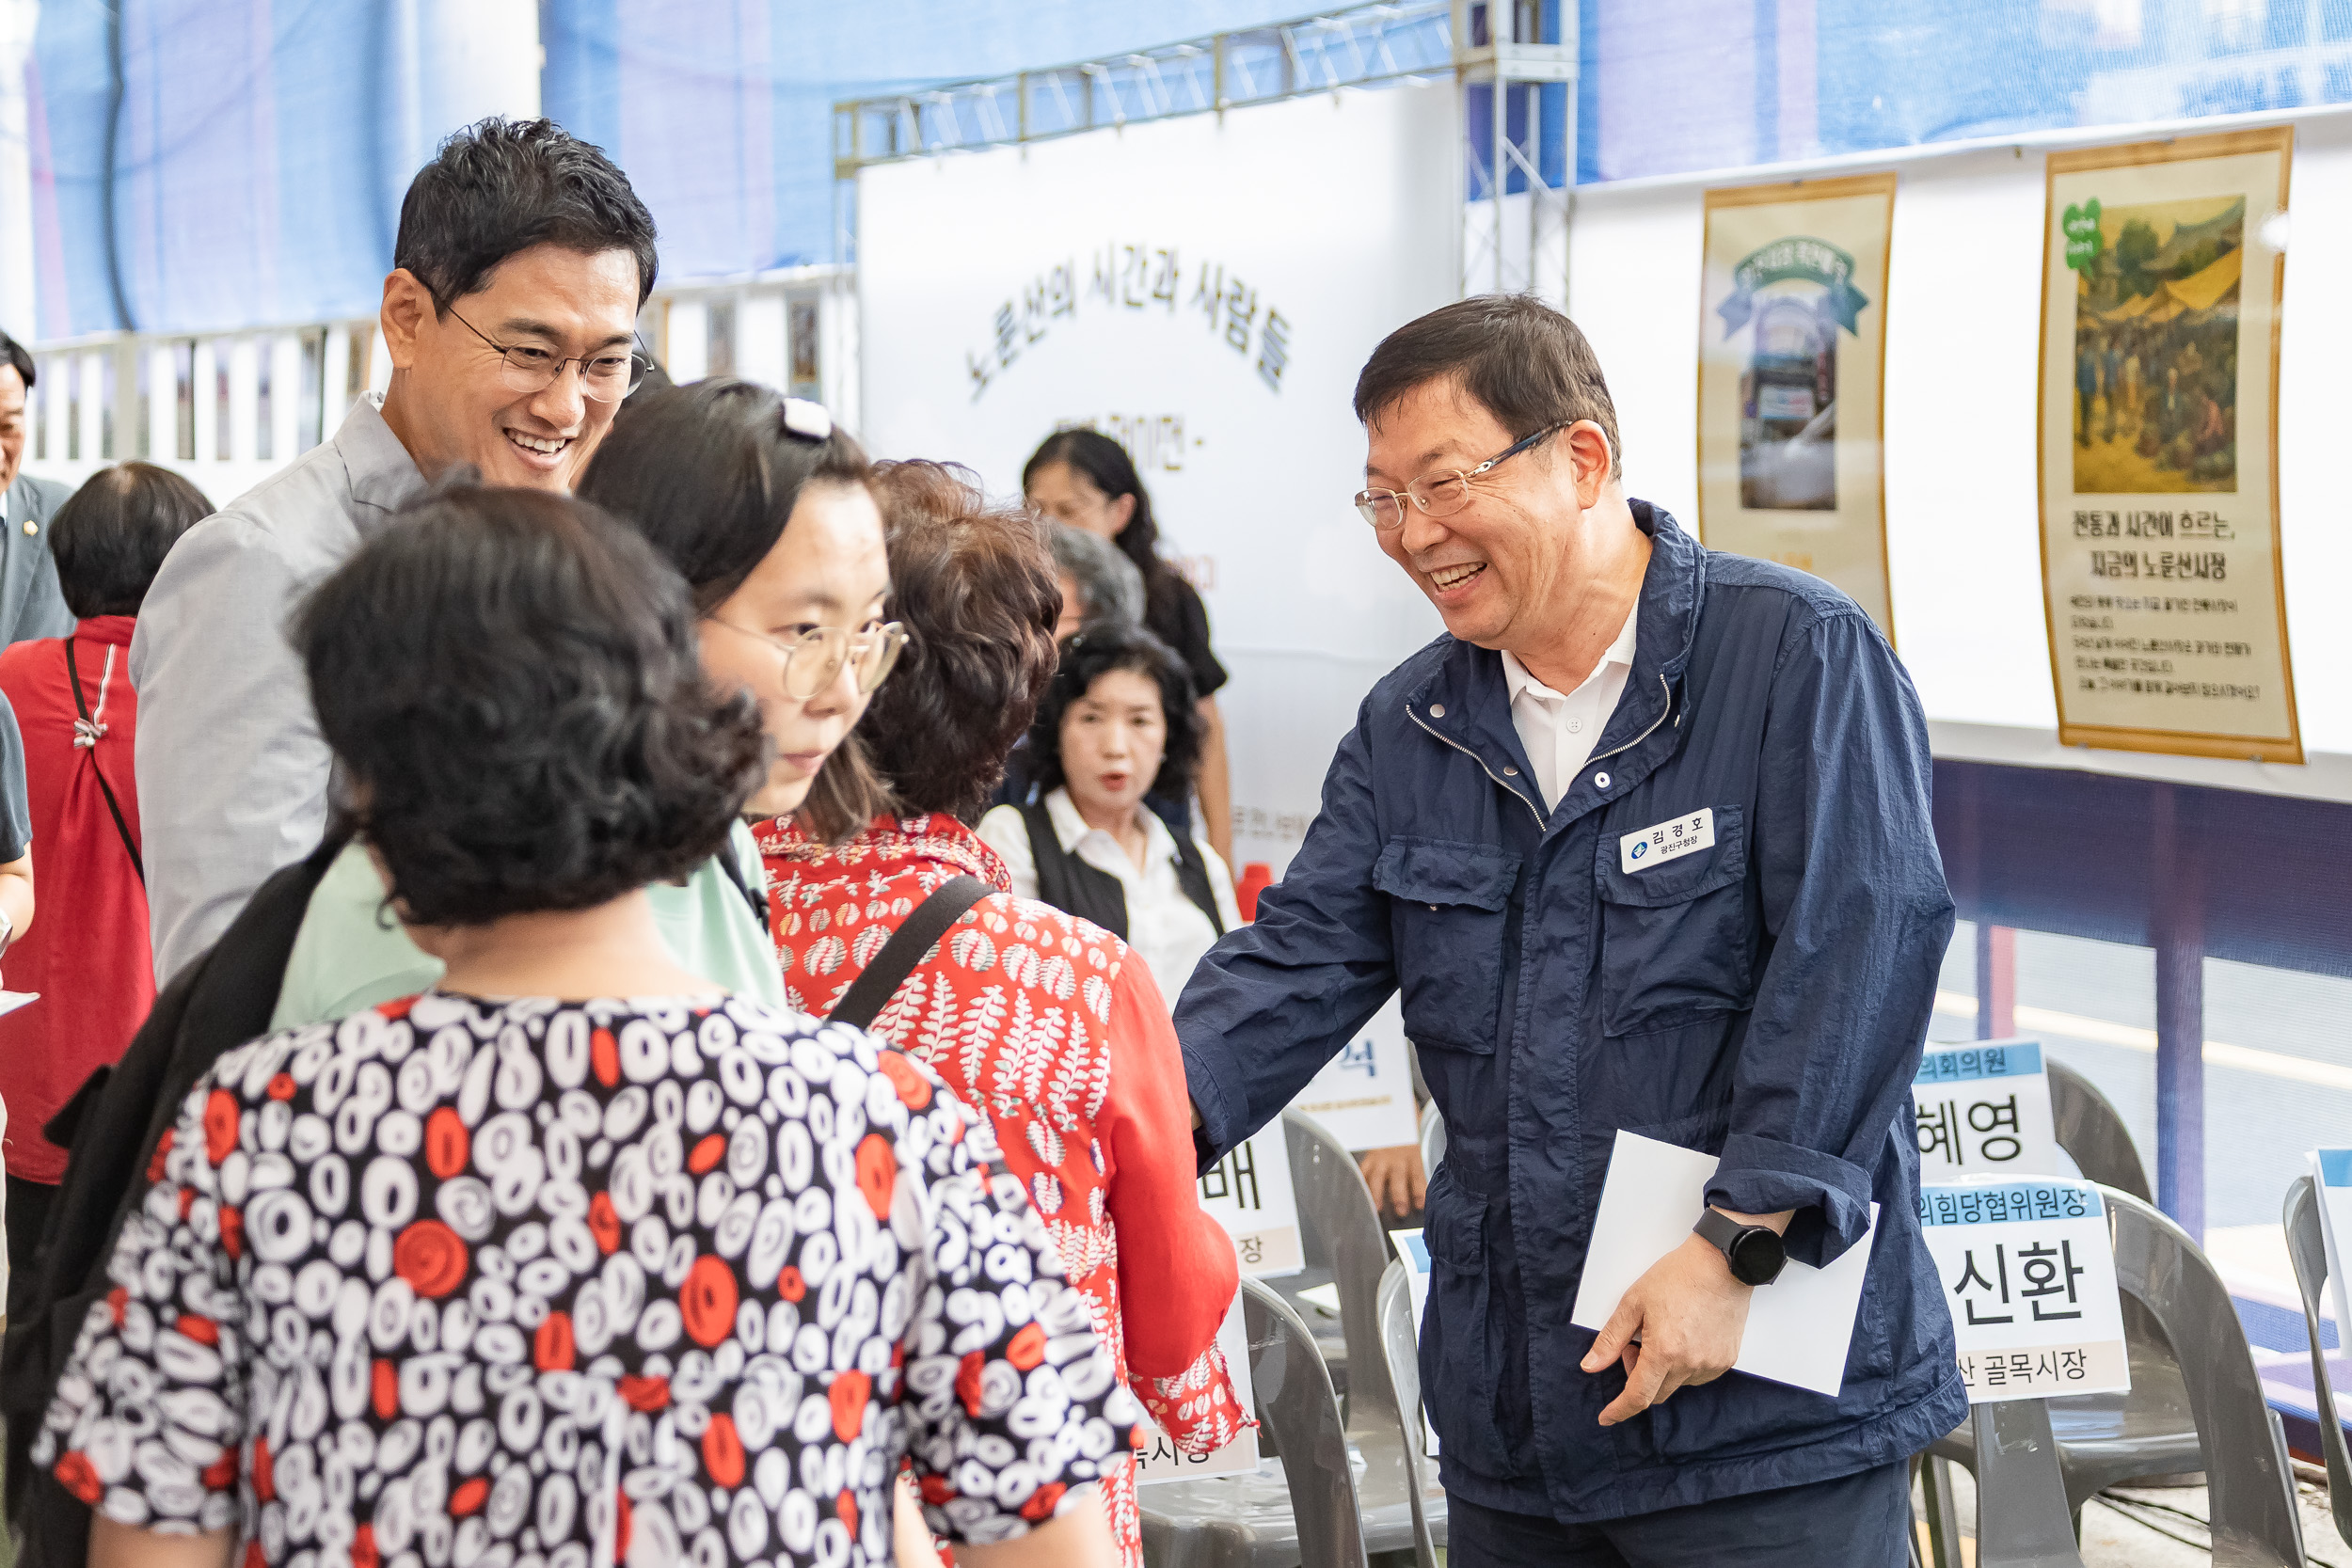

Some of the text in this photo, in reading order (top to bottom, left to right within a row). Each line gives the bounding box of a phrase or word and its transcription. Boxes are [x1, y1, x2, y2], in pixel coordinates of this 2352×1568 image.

[1088, 241, 1179, 312] 시간과
[1190, 261, 1291, 396] 사람들
[1660, 834, 1698, 855] 광진구청장
[1916, 1094, 2022, 1165] 혜영
[1239, 1236, 1263, 1263] 장
[1953, 1239, 2085, 1325] 신환
[1984, 1348, 2087, 1386] 골목시장
